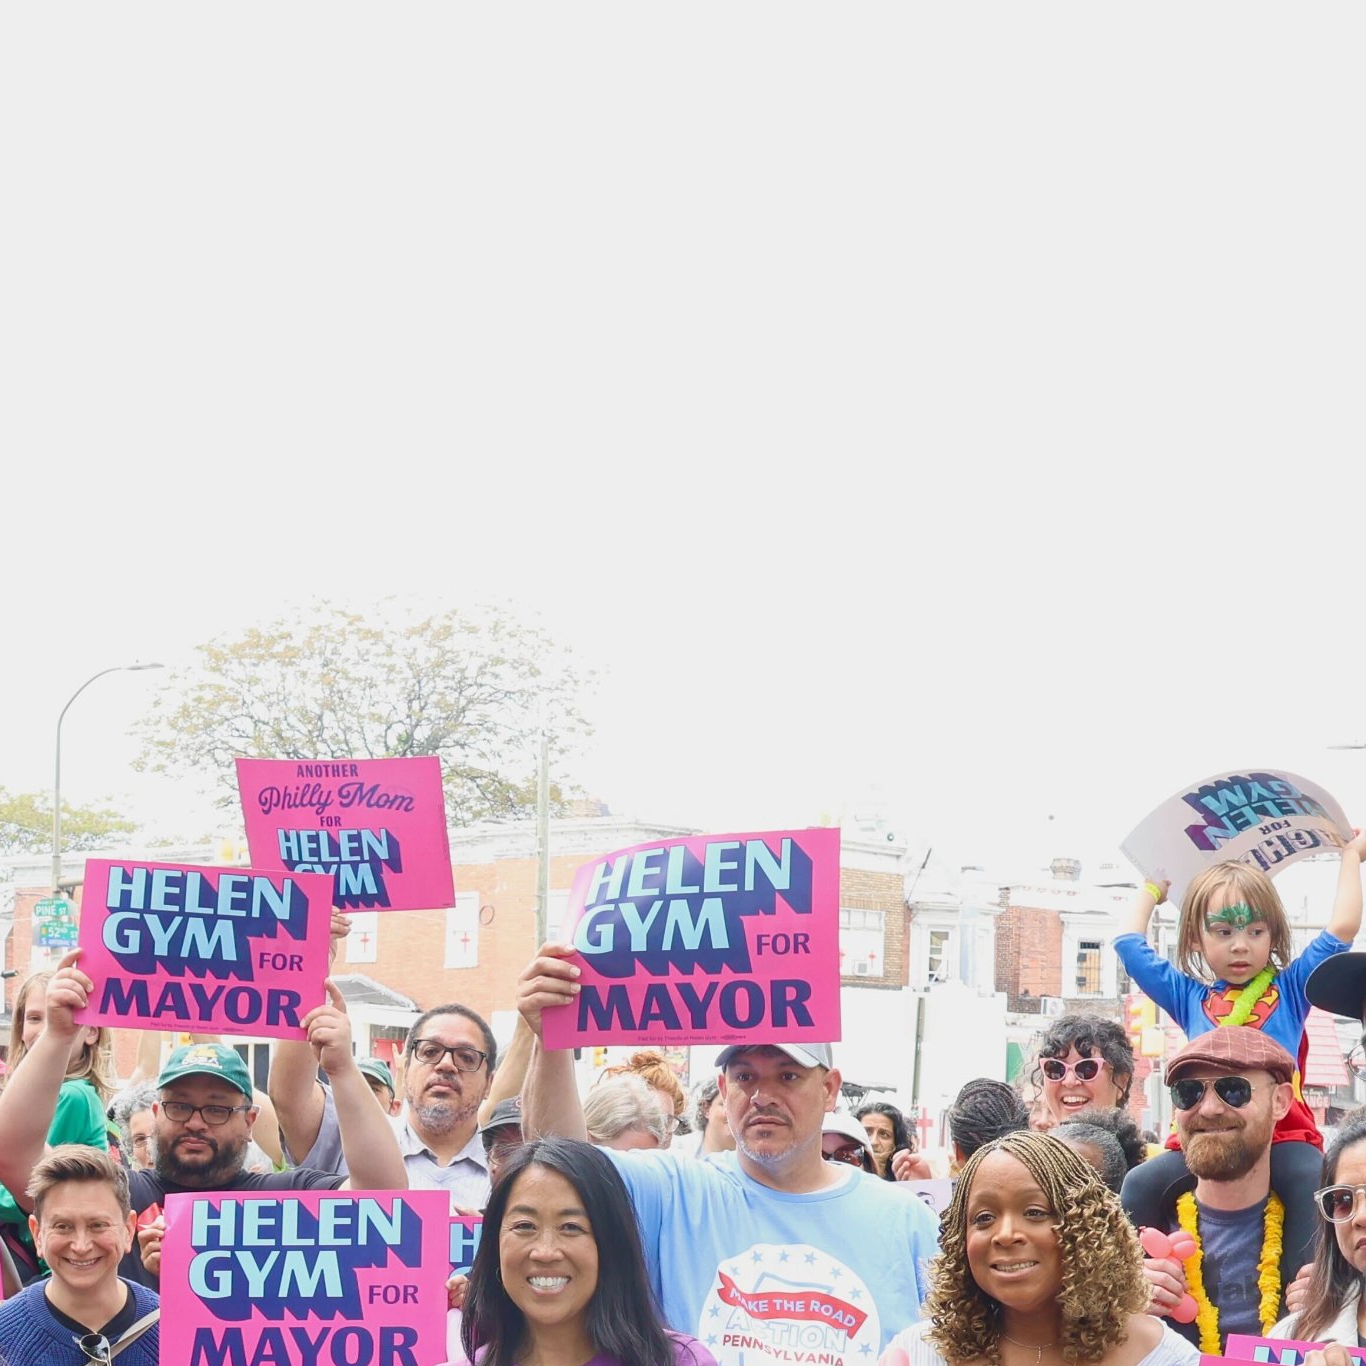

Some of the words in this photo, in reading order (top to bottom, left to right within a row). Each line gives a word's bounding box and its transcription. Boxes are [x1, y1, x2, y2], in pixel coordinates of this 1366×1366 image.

[297, 764, 358, 778] ANOTHER
[258, 783, 334, 816] Philly
[338, 782, 415, 812] Mom
[1200, 780, 1303, 816] GYM
[320, 815, 341, 827] FOR
[1262, 819, 1291, 835] FOR
[277, 828, 389, 862] HELEN
[106, 865, 292, 920] HELEN
[585, 838, 791, 907] HELEN
[35, 904, 57, 916] PINE
[58, 907, 67, 915] ST
[573, 897, 730, 955] GYM
[756, 934, 810, 955] FOR
[102, 912, 237, 961] GYM
[258, 952, 303, 971] FOR
[99, 978, 304, 1027] MAYOR
[577, 979, 815, 1032] MAYOR
[192, 1198, 402, 1246] HELEN
[188, 1250, 344, 1299] GYM
[369, 1285, 418, 1304] FOR
[730, 1287, 768, 1312] MAKE
[773, 1300, 804, 1311] THE
[810, 1300, 855, 1327] ROAD
[726, 1308, 848, 1352] ACTION
